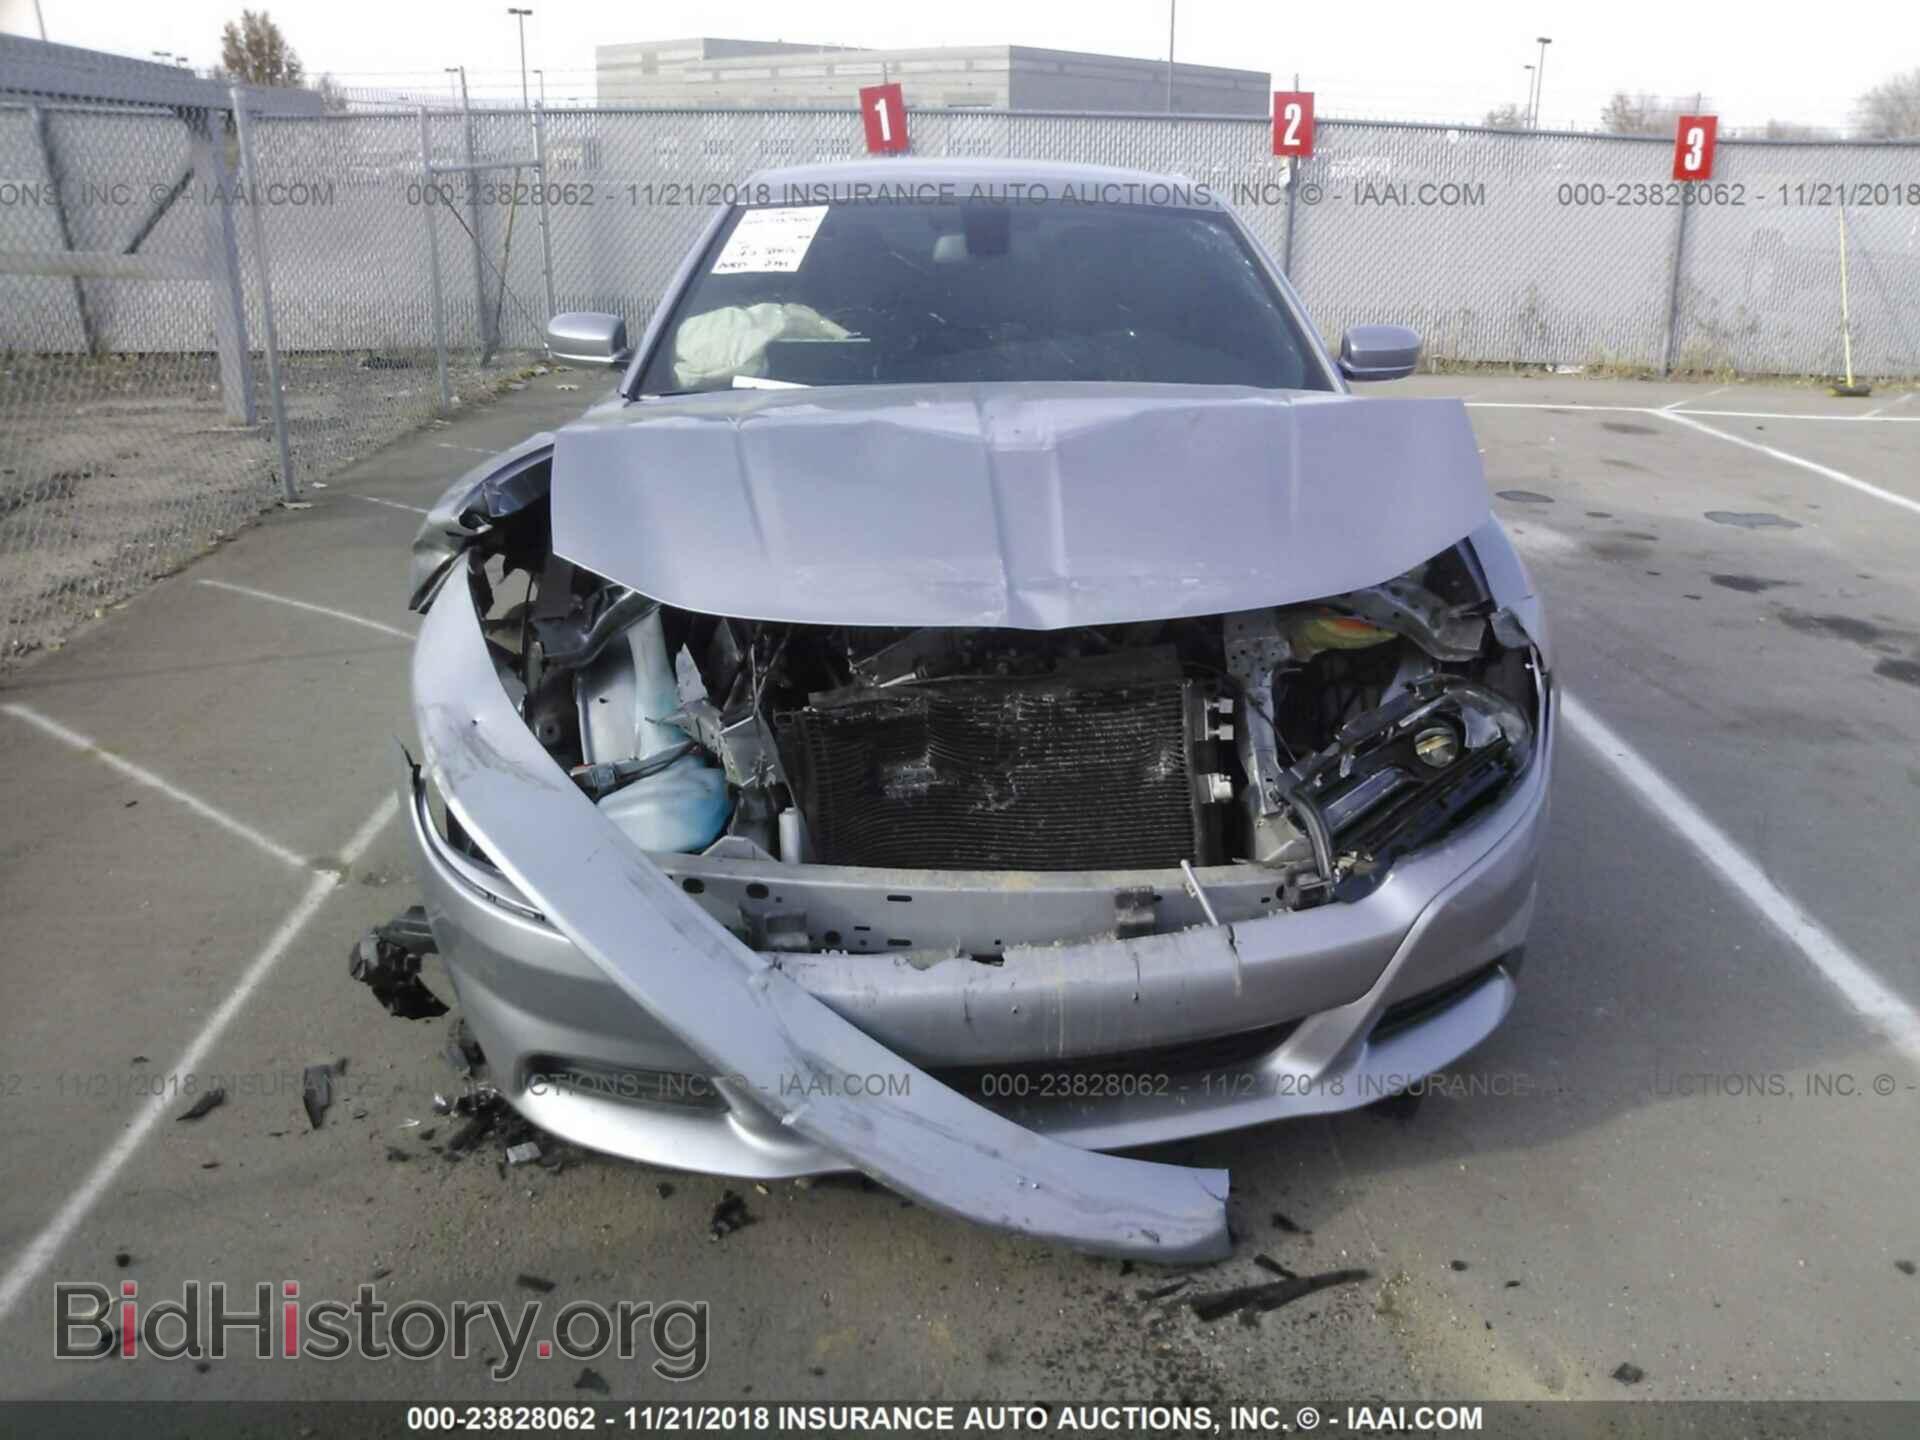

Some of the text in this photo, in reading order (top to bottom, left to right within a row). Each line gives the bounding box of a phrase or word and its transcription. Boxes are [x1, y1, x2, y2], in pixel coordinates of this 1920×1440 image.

[874, 98, 891, 141] 1
[1283, 103, 1302, 146] 2
[1684, 127, 1704, 171] 3
